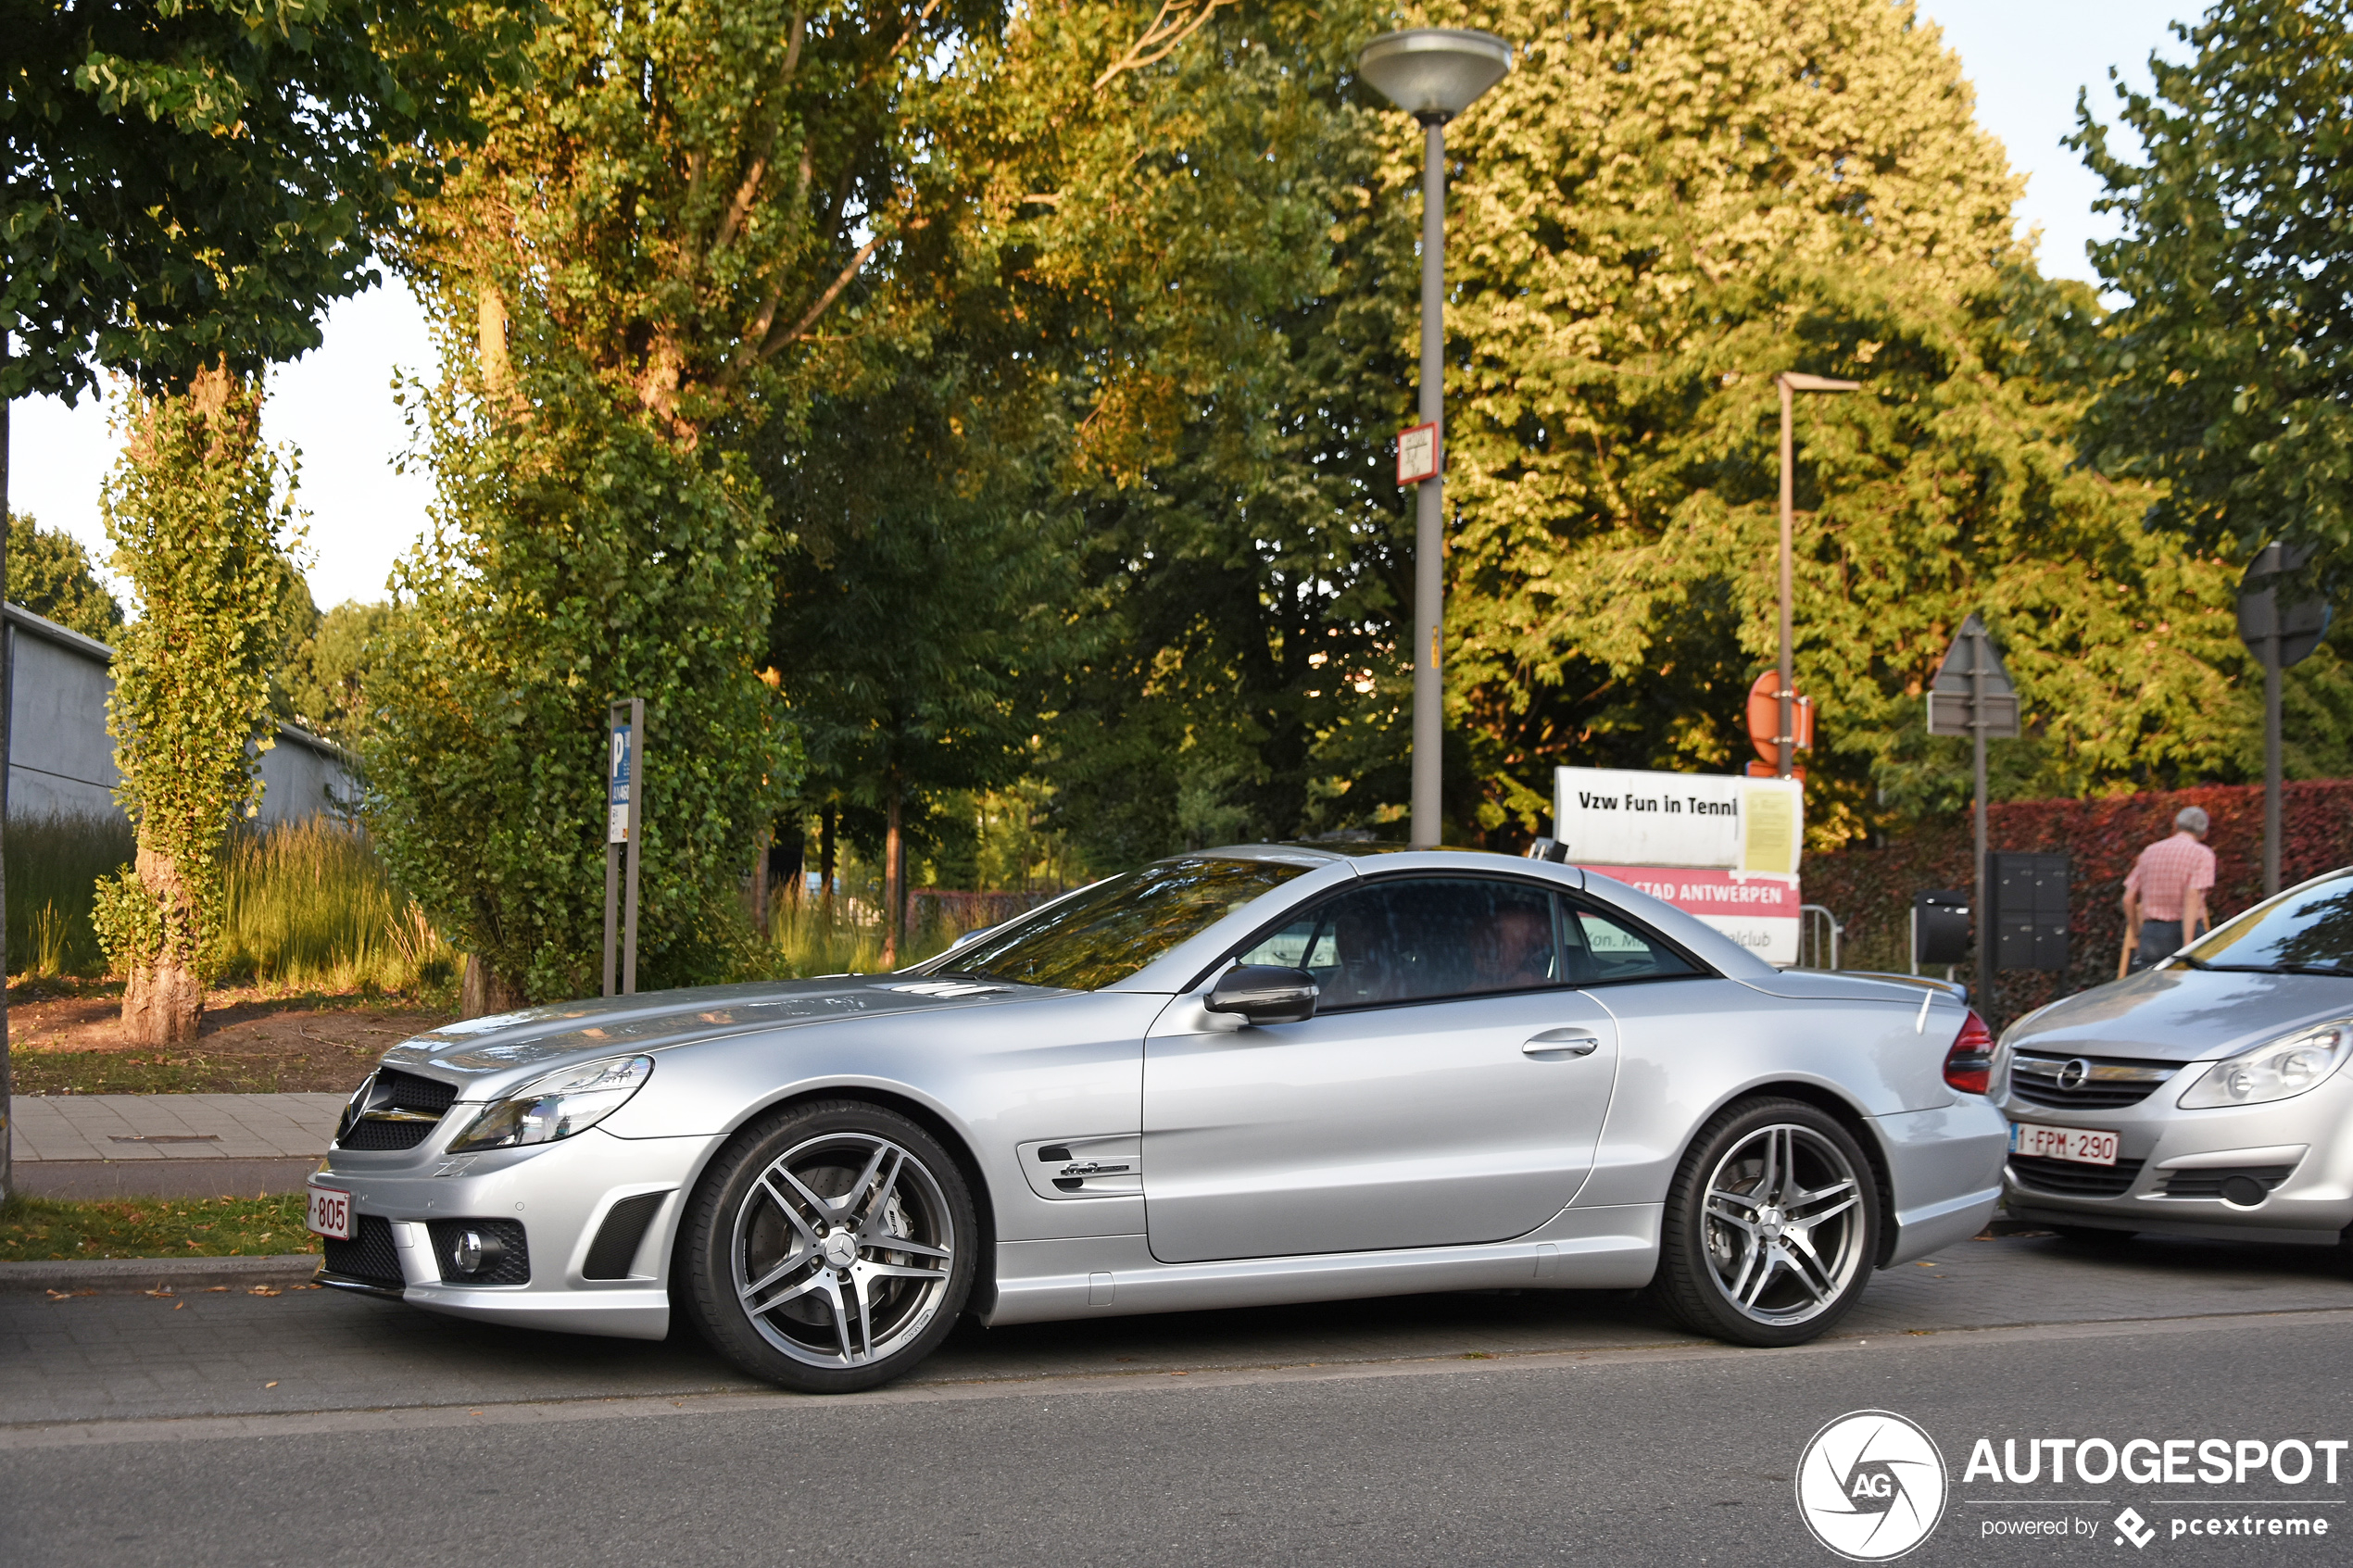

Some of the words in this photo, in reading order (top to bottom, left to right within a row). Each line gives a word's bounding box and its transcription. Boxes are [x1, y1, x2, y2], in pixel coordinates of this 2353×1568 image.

[613, 733, 624, 778] P
[1579, 791, 1618, 810] Vzw
[1625, 794, 1657, 812] Fun
[1664, 795, 1681, 813] in
[1680, 884, 1782, 904] ANTWERPEN
[1588, 932, 1616, 947] on.
[2020, 1127, 2113, 1160] 1-FPM-290
